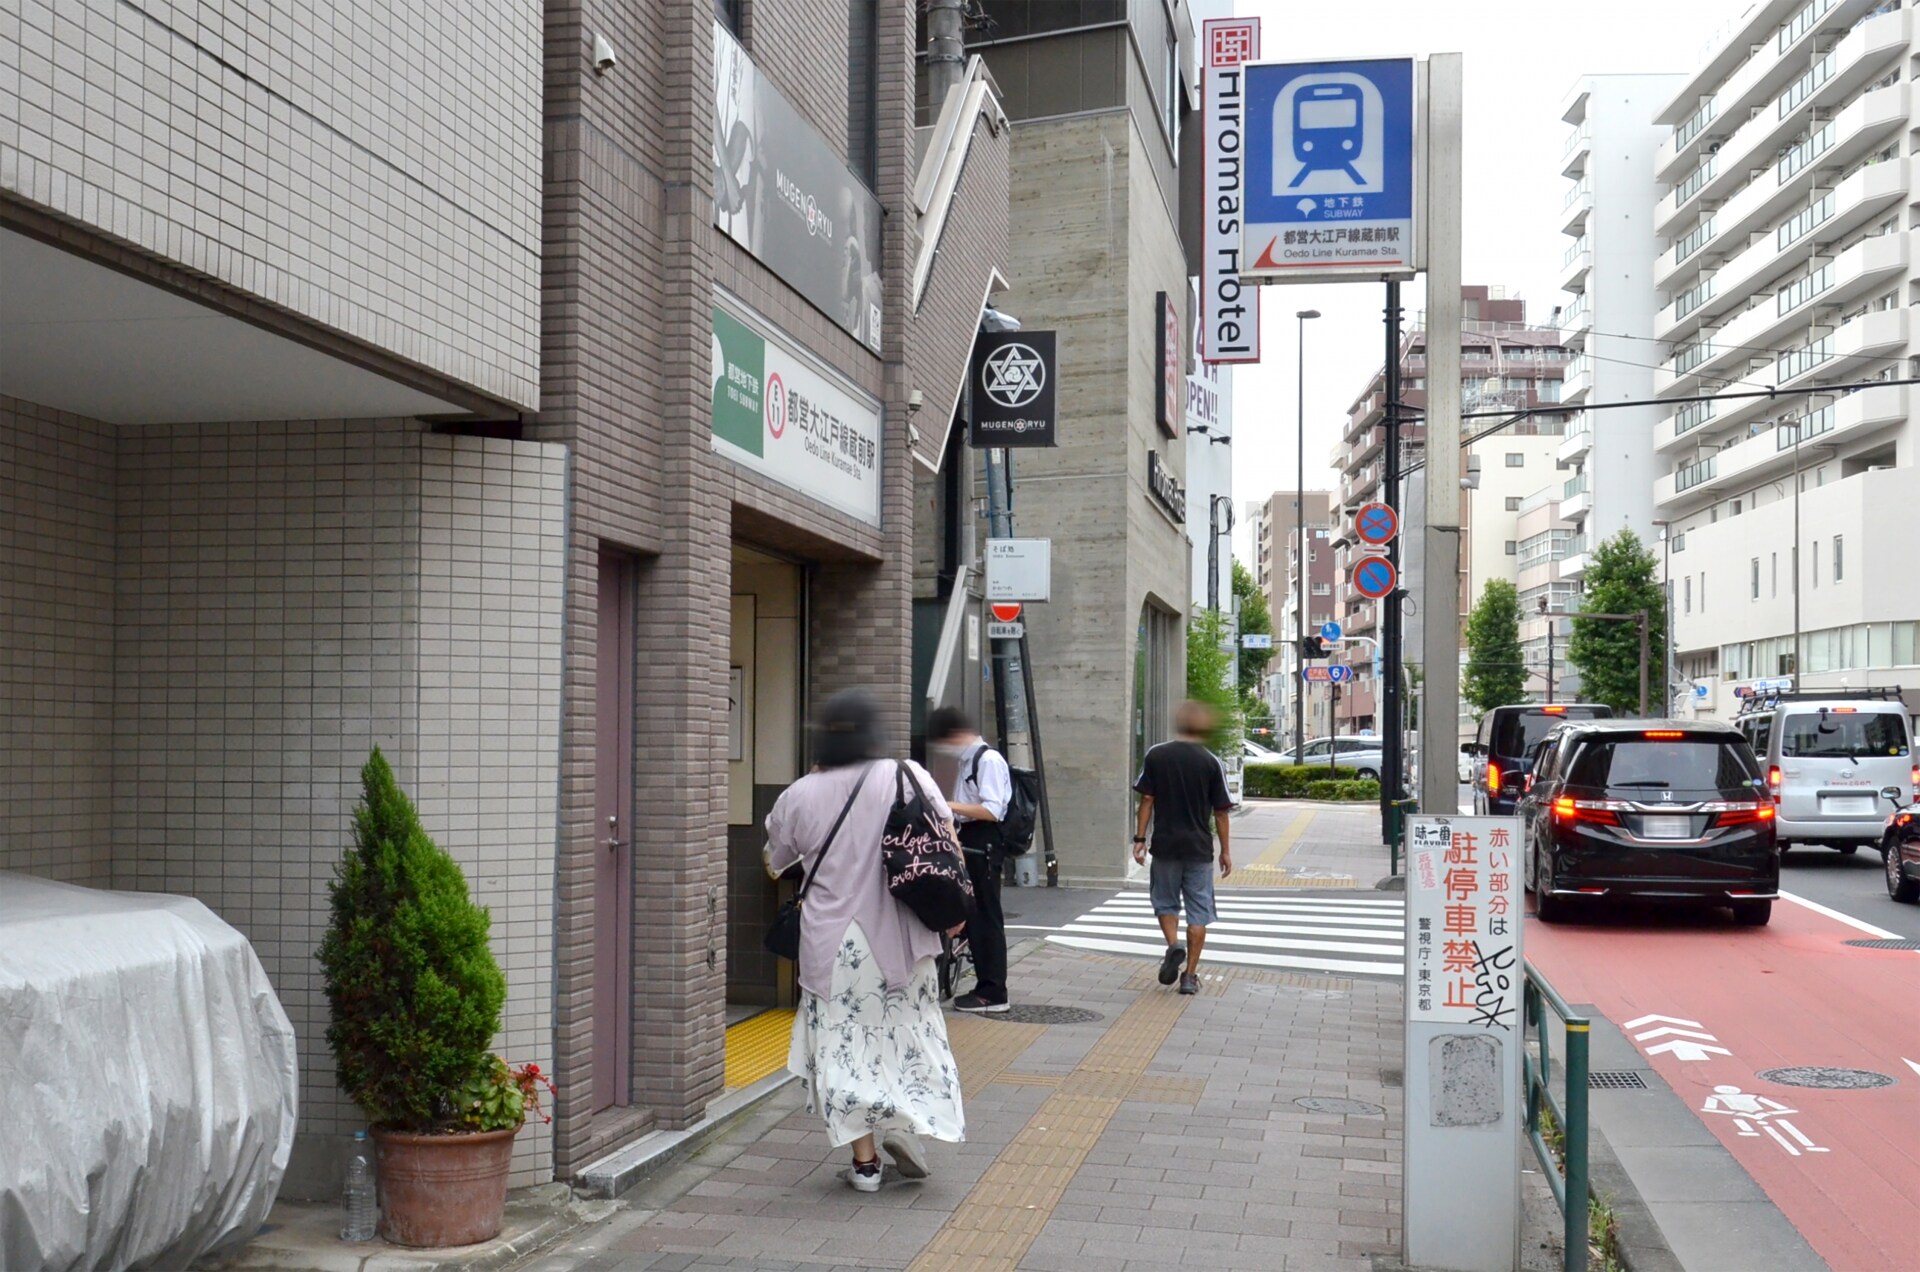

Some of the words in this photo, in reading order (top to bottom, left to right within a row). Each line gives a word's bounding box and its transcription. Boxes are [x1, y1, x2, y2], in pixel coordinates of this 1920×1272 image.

[776, 168, 807, 215] MUGEN
[817, 209, 833, 239] RYU
[1323, 197, 1364, 209] 地下鉄
[1323, 209, 1364, 219] SUBWAY
[1283, 226, 1400, 245] 都営大江戸線蔵前駅
[1283, 249, 1310, 259] Oedo
[1312, 248, 1333, 258] Line
[1334, 246, 1378, 257] Kuramae
[1381, 246, 1400, 256] Sta.
[1218, 249, 1250, 353] Hotel
[727, 384, 739, 402] TOEI
[739, 392, 759, 414] SUBWAY
[773, 384, 778, 402] E
[771, 403, 781, 425] 11
[980, 420, 1014, 429] MUGEN
[1027, 420, 1046, 428] RYU
[787, 387, 876, 472] 都営大江戸線蔵前駅
[804, 436, 819, 457] Oedo
[819, 443, 831, 464] Line
[831, 452, 853, 476] Kuramae
[1332, 667, 1341, 679] 6
[1414, 825, 1451, 841] 味一番
[1488, 827, 1511, 936] 赤い部分は
[1442, 831, 1479, 1009] 駐停車禁止
[1417, 917, 1432, 1012] 警視庁・東京都
